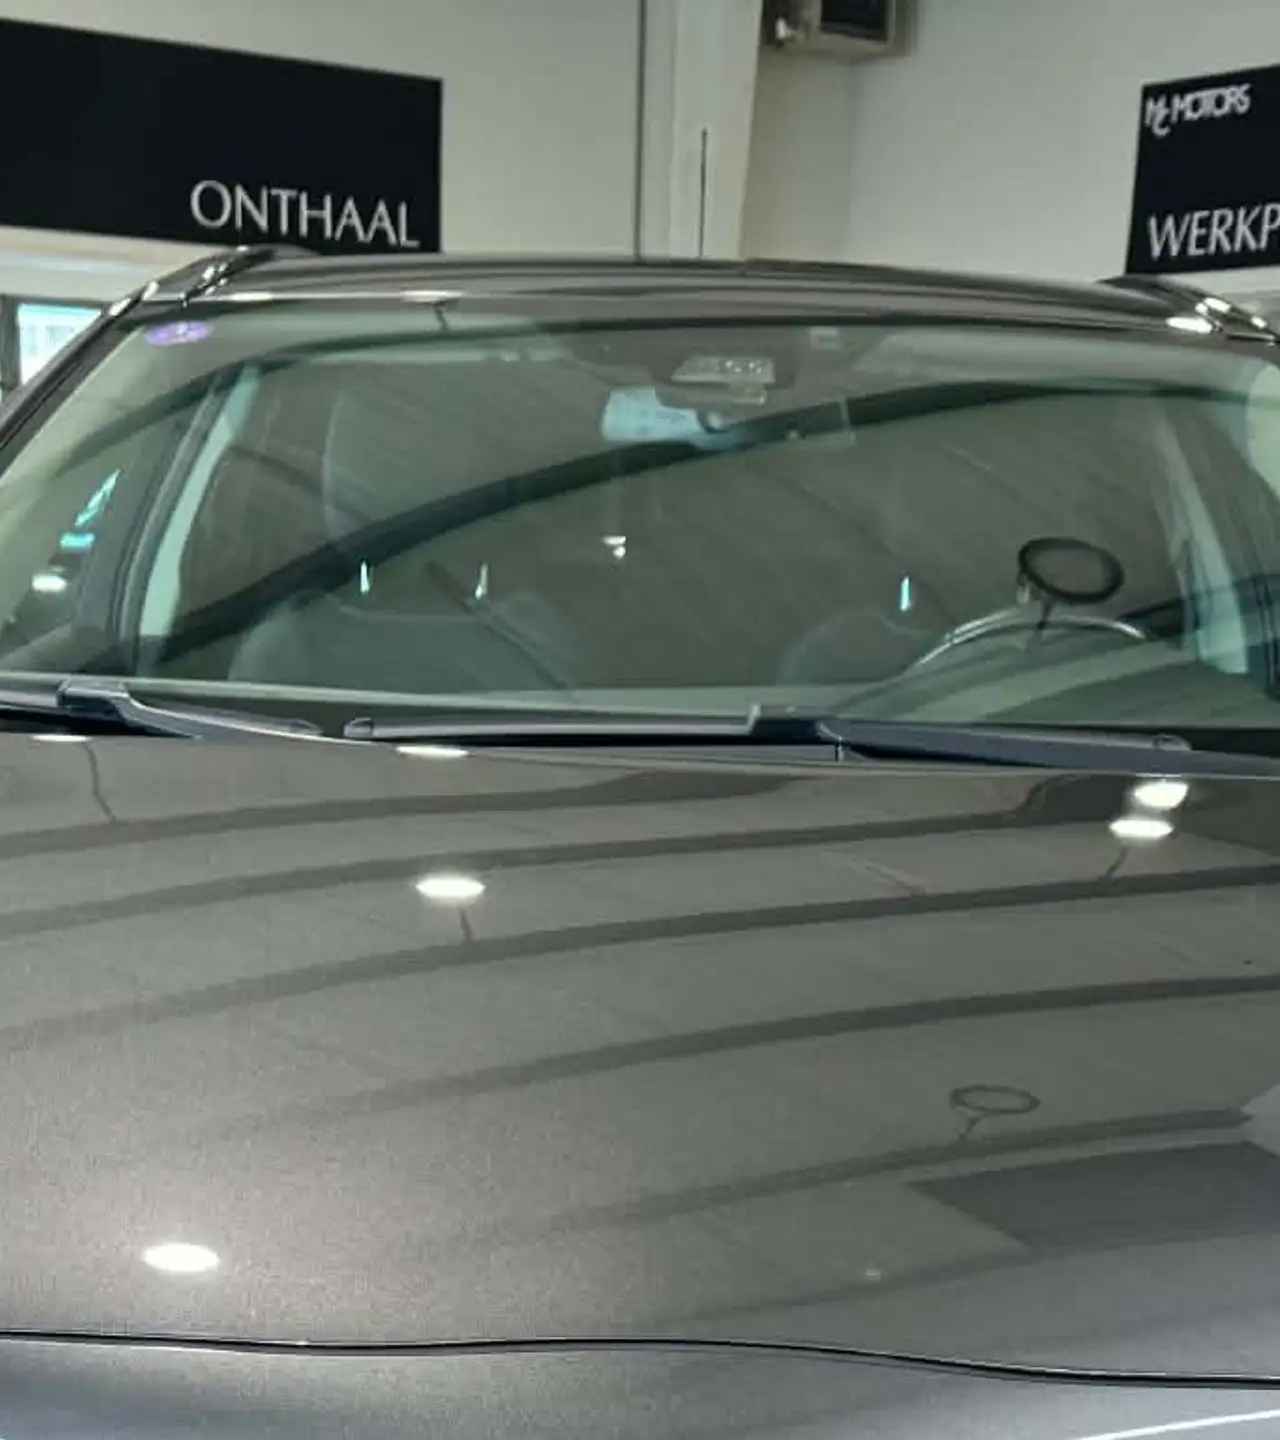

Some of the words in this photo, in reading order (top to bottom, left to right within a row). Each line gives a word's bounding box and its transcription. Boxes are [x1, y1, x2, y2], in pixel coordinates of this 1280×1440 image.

[1145, 93, 1171, 136] MC
[1171, 83, 1252, 124] MOTORS
[189, 179, 421, 248] ONTHAAL
